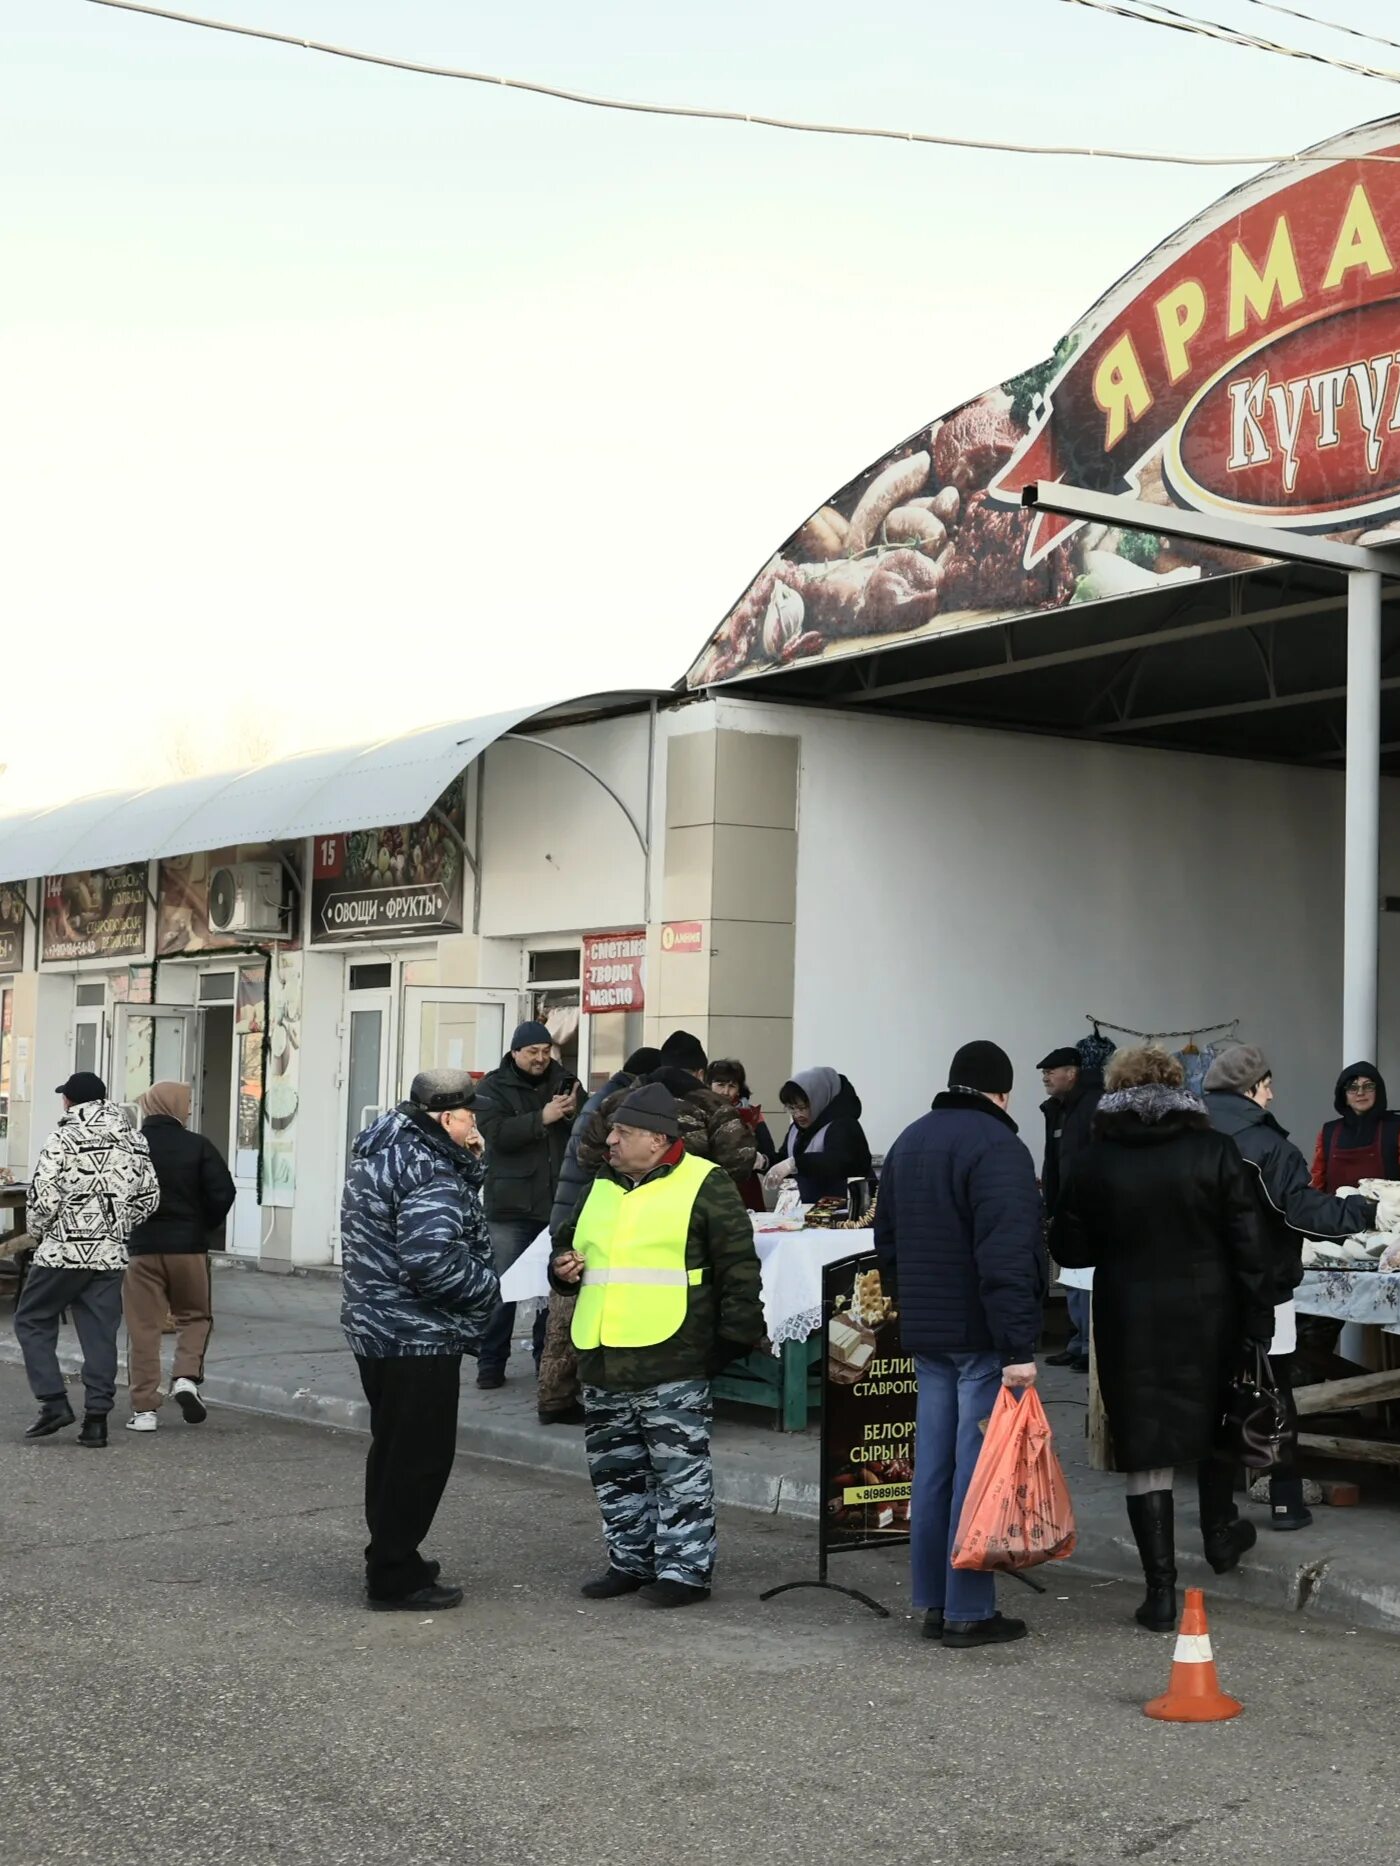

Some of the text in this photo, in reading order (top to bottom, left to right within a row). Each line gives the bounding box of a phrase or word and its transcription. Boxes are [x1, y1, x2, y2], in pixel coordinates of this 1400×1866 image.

[320, 840, 336, 866] 15
[334, 894, 436, 924] ОВОЩИ ФРУКТЫ
[589, 963, 634, 984] творог
[589, 986, 634, 1007] масло
[869, 1358, 916, 1379] ДЕЛИ
[850, 1444, 894, 1463] СЫРЫ
[898, 1443, 910, 1459] И
